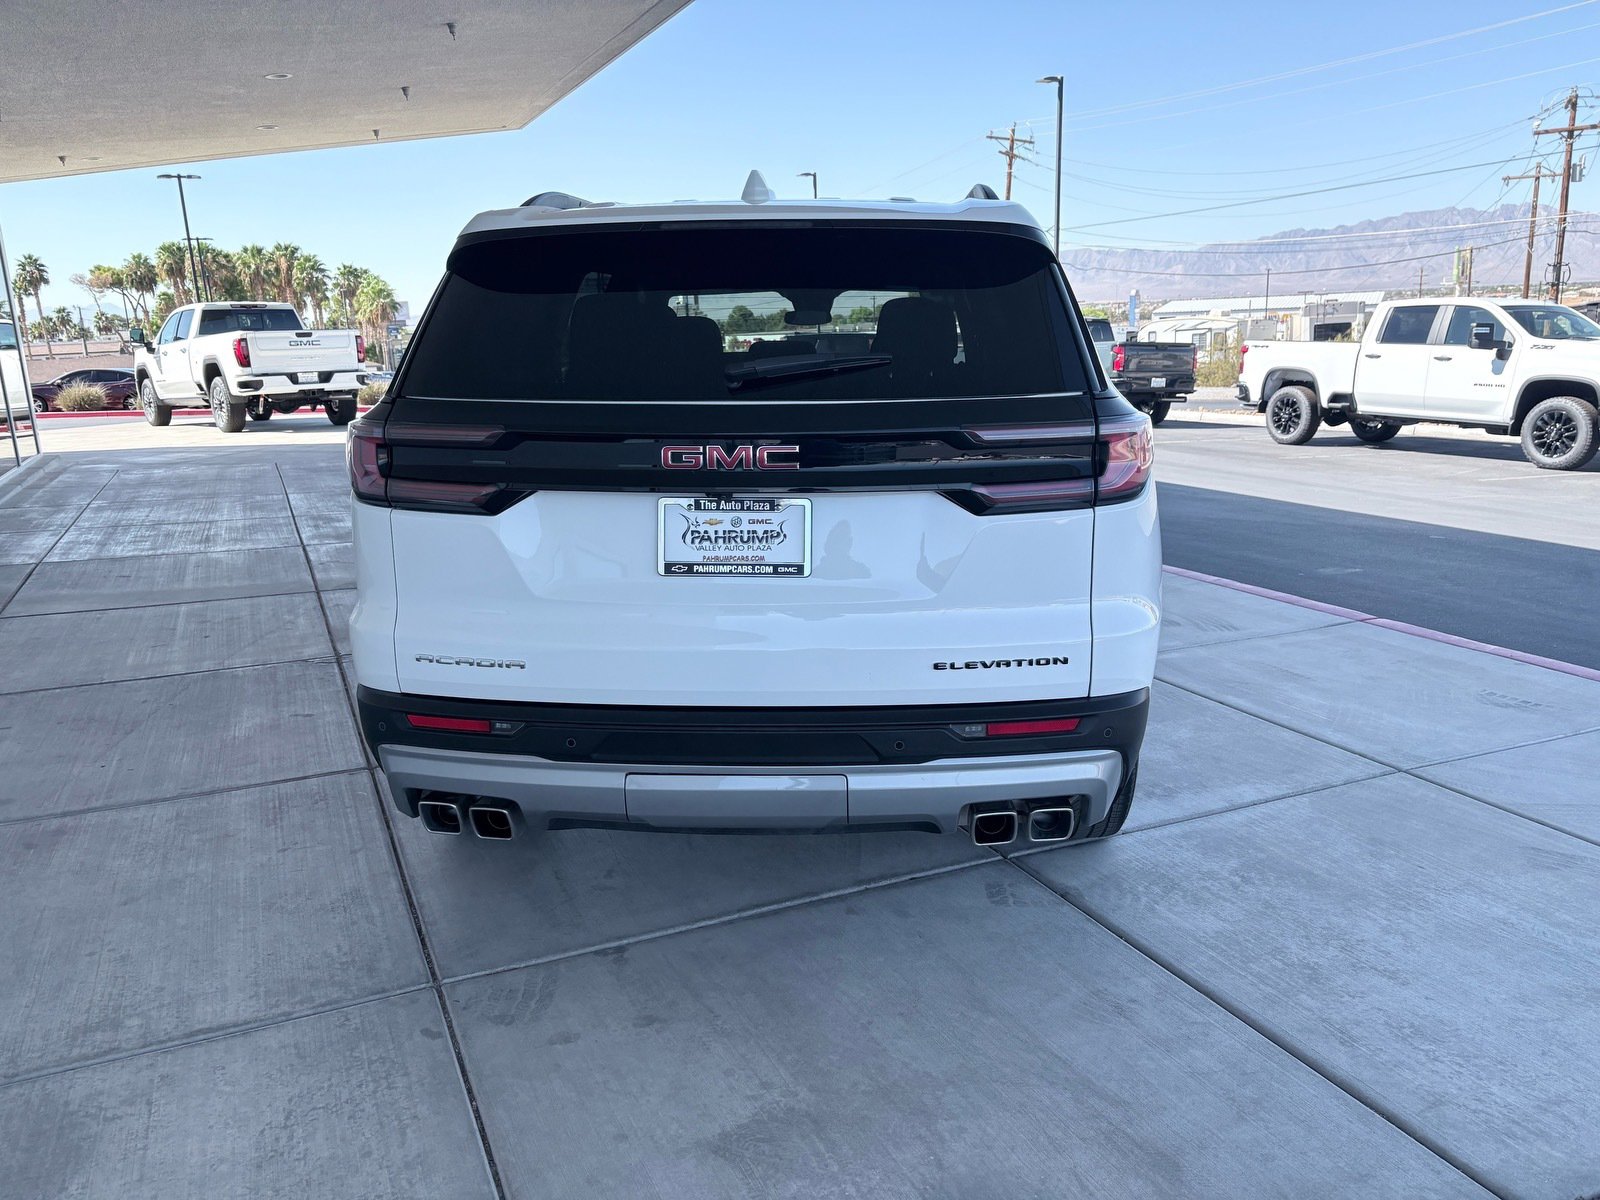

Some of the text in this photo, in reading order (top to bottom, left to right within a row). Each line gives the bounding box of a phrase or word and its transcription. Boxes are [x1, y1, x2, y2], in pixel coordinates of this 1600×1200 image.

[661, 445, 800, 470] GMC
[700, 500, 770, 511] The Auto Plaza
[690, 529, 782, 545] PAHRUMP
[693, 563, 773, 574] PAHRUMPCARS.COM
[415, 653, 526, 670] ACADIA
[932, 656, 1069, 671] ELEVATION
